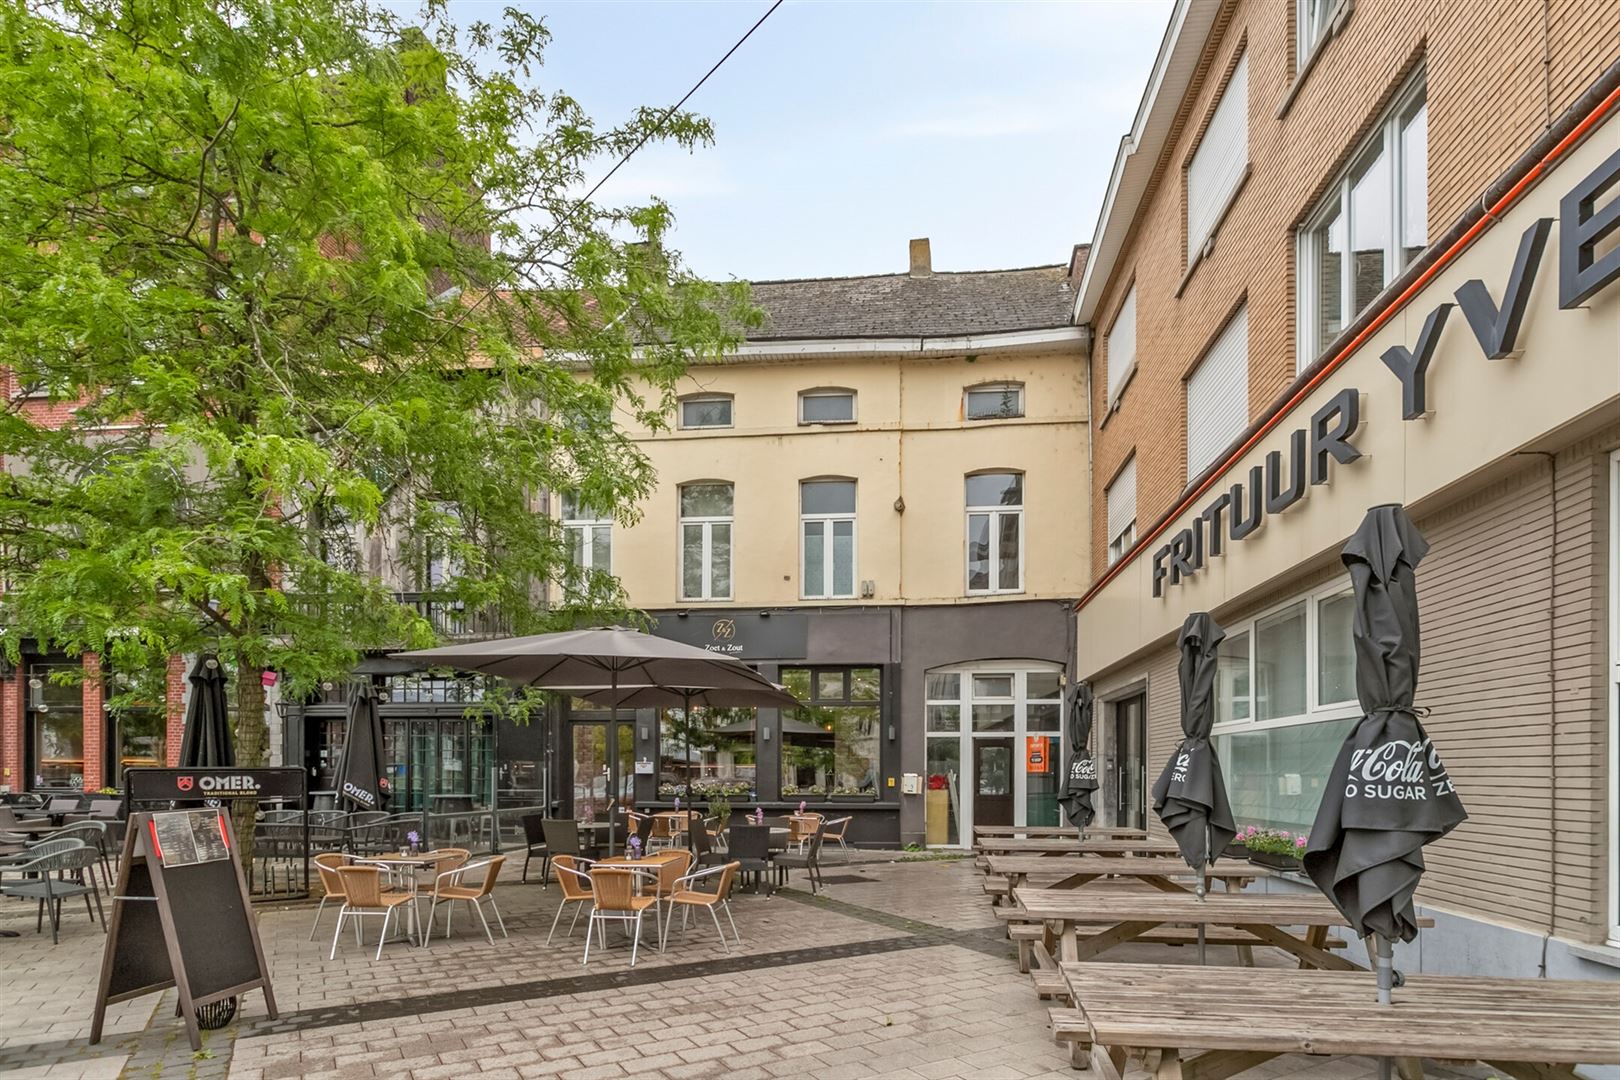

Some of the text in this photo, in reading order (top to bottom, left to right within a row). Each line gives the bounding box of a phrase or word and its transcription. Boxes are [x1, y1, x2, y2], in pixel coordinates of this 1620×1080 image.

[1152, 388, 1363, 598] FRITUUR
[705, 644, 720, 652] Zoet
[727, 644, 743, 652] Zout
[1364, 784, 1427, 800] SUGAR
